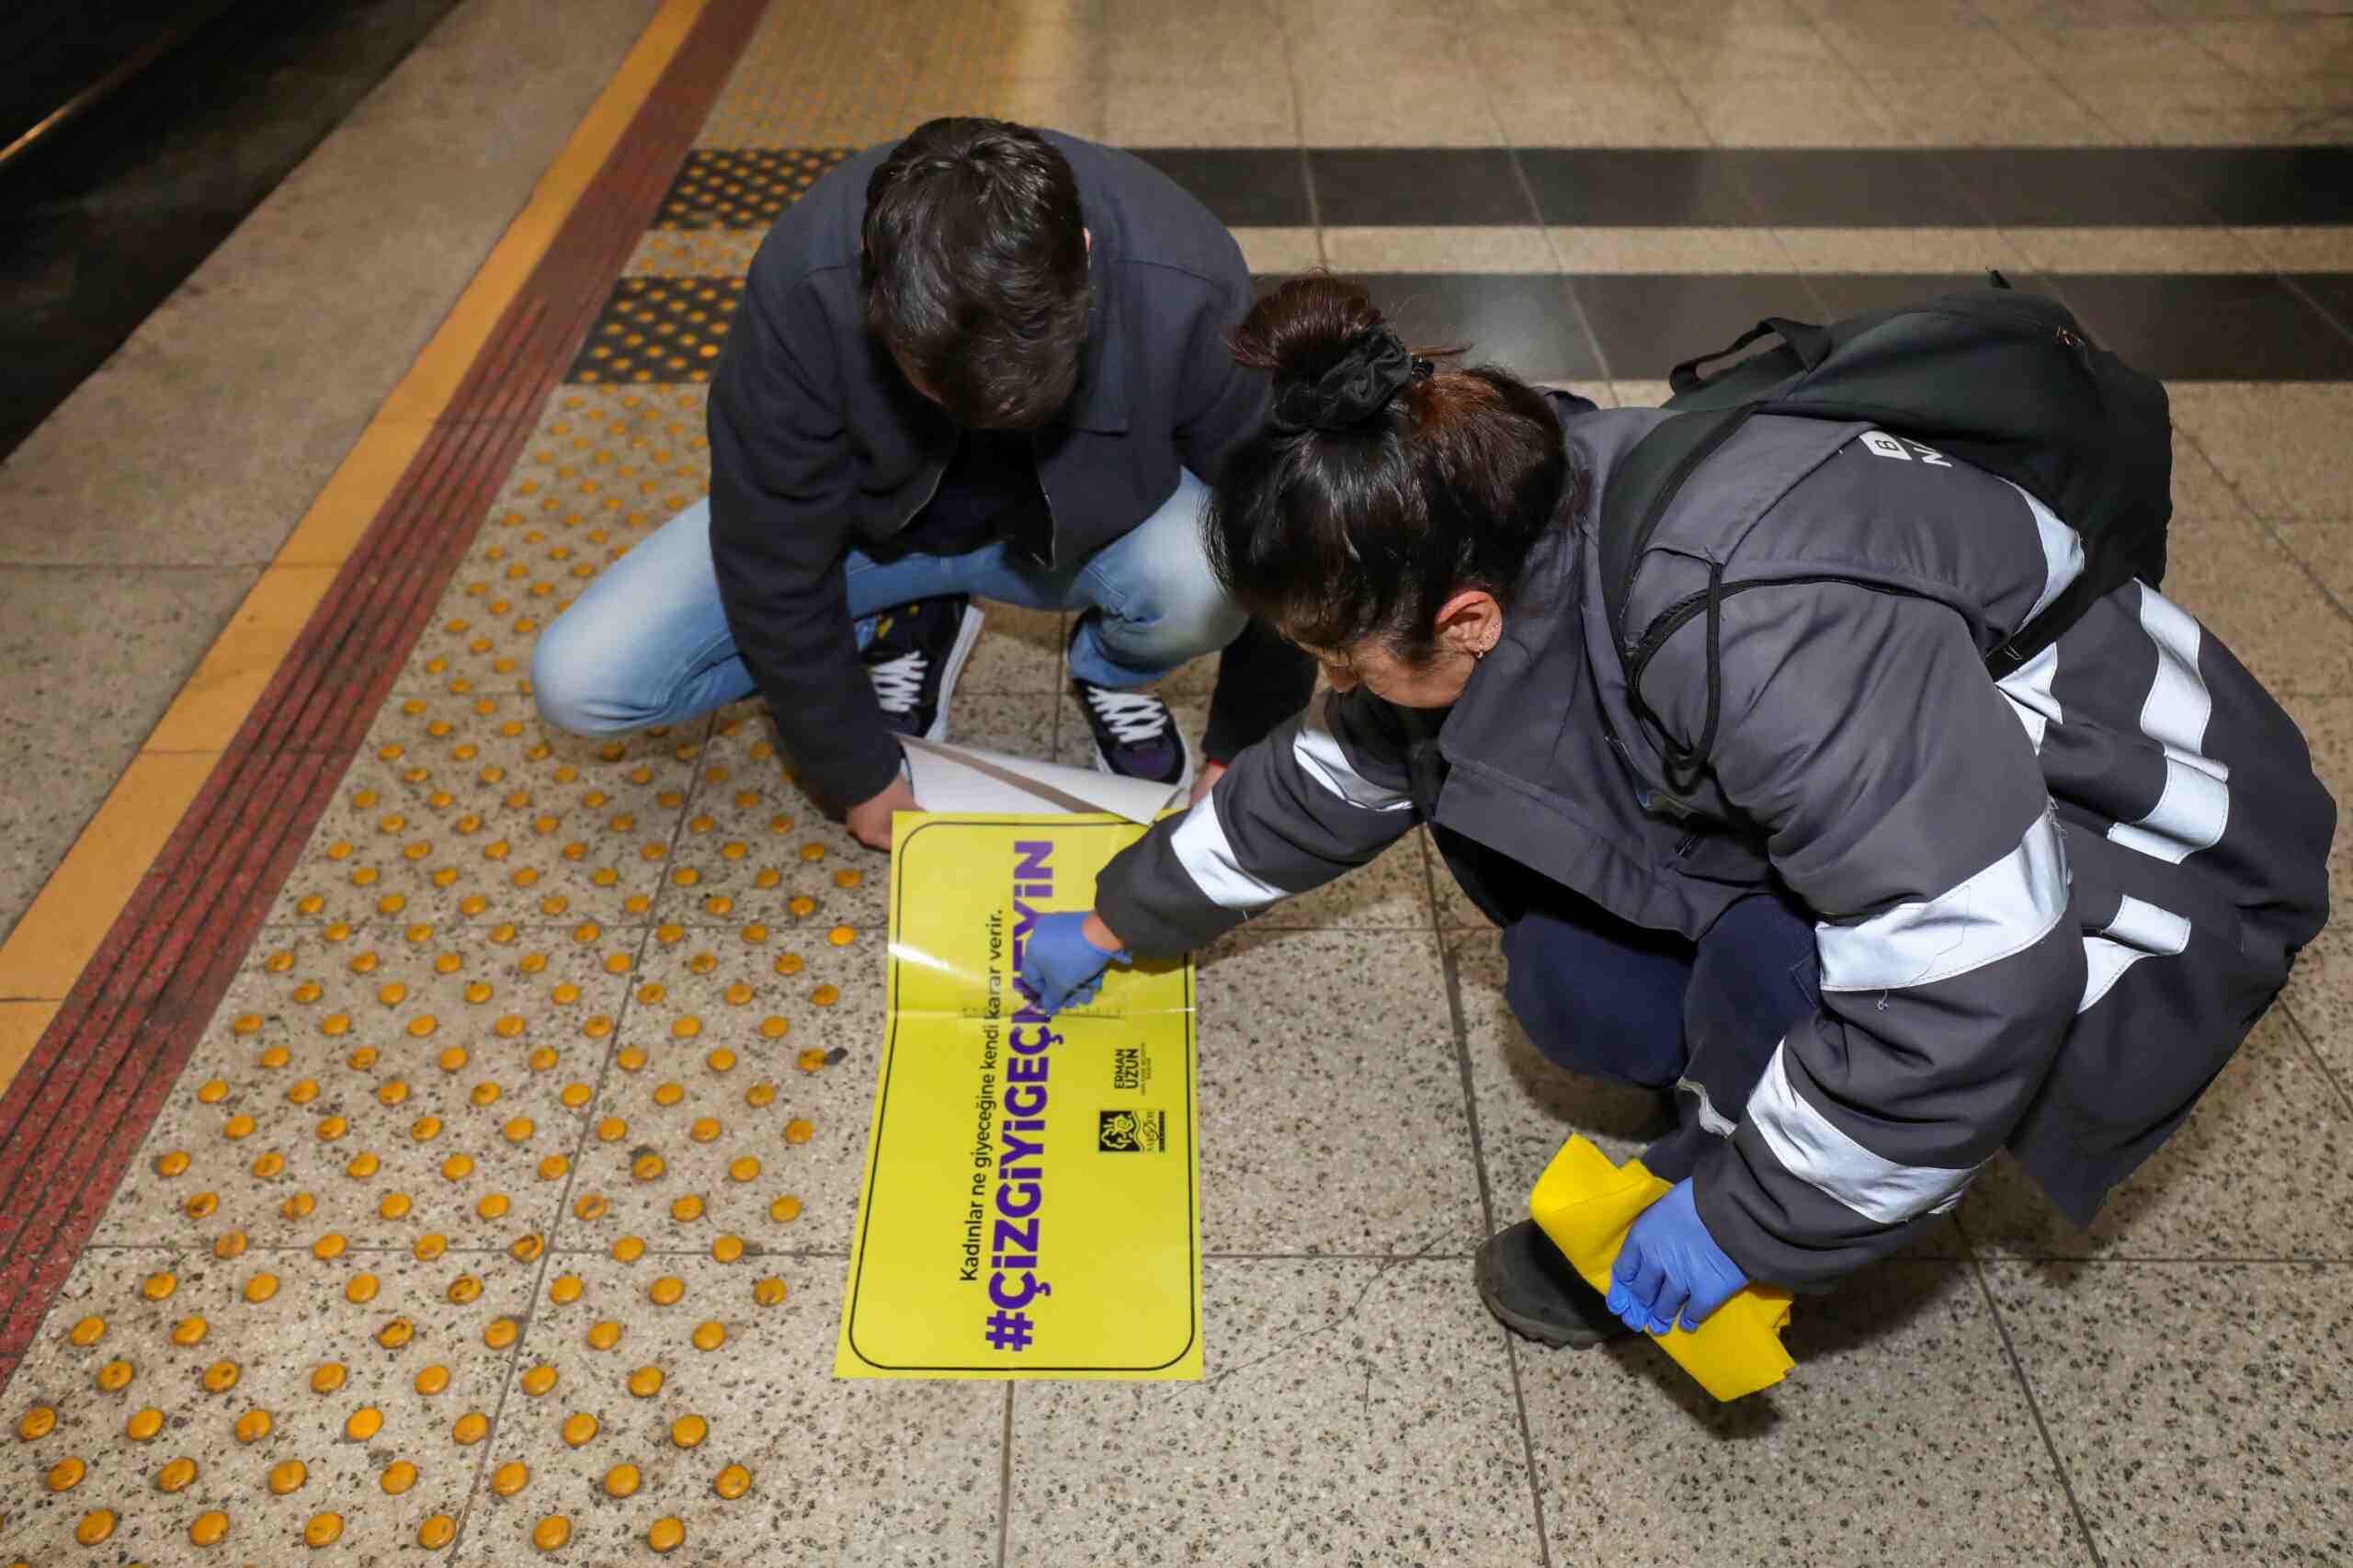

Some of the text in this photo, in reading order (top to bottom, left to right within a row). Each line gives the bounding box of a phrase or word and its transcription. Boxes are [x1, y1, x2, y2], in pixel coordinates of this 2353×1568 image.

[1114, 1048, 1125, 1089] ERMAN
[1125, 1048, 1139, 1089] UZUN
[960, 909, 1004, 1281] Kadınlar ne giyeceğine kendi karar verir.
